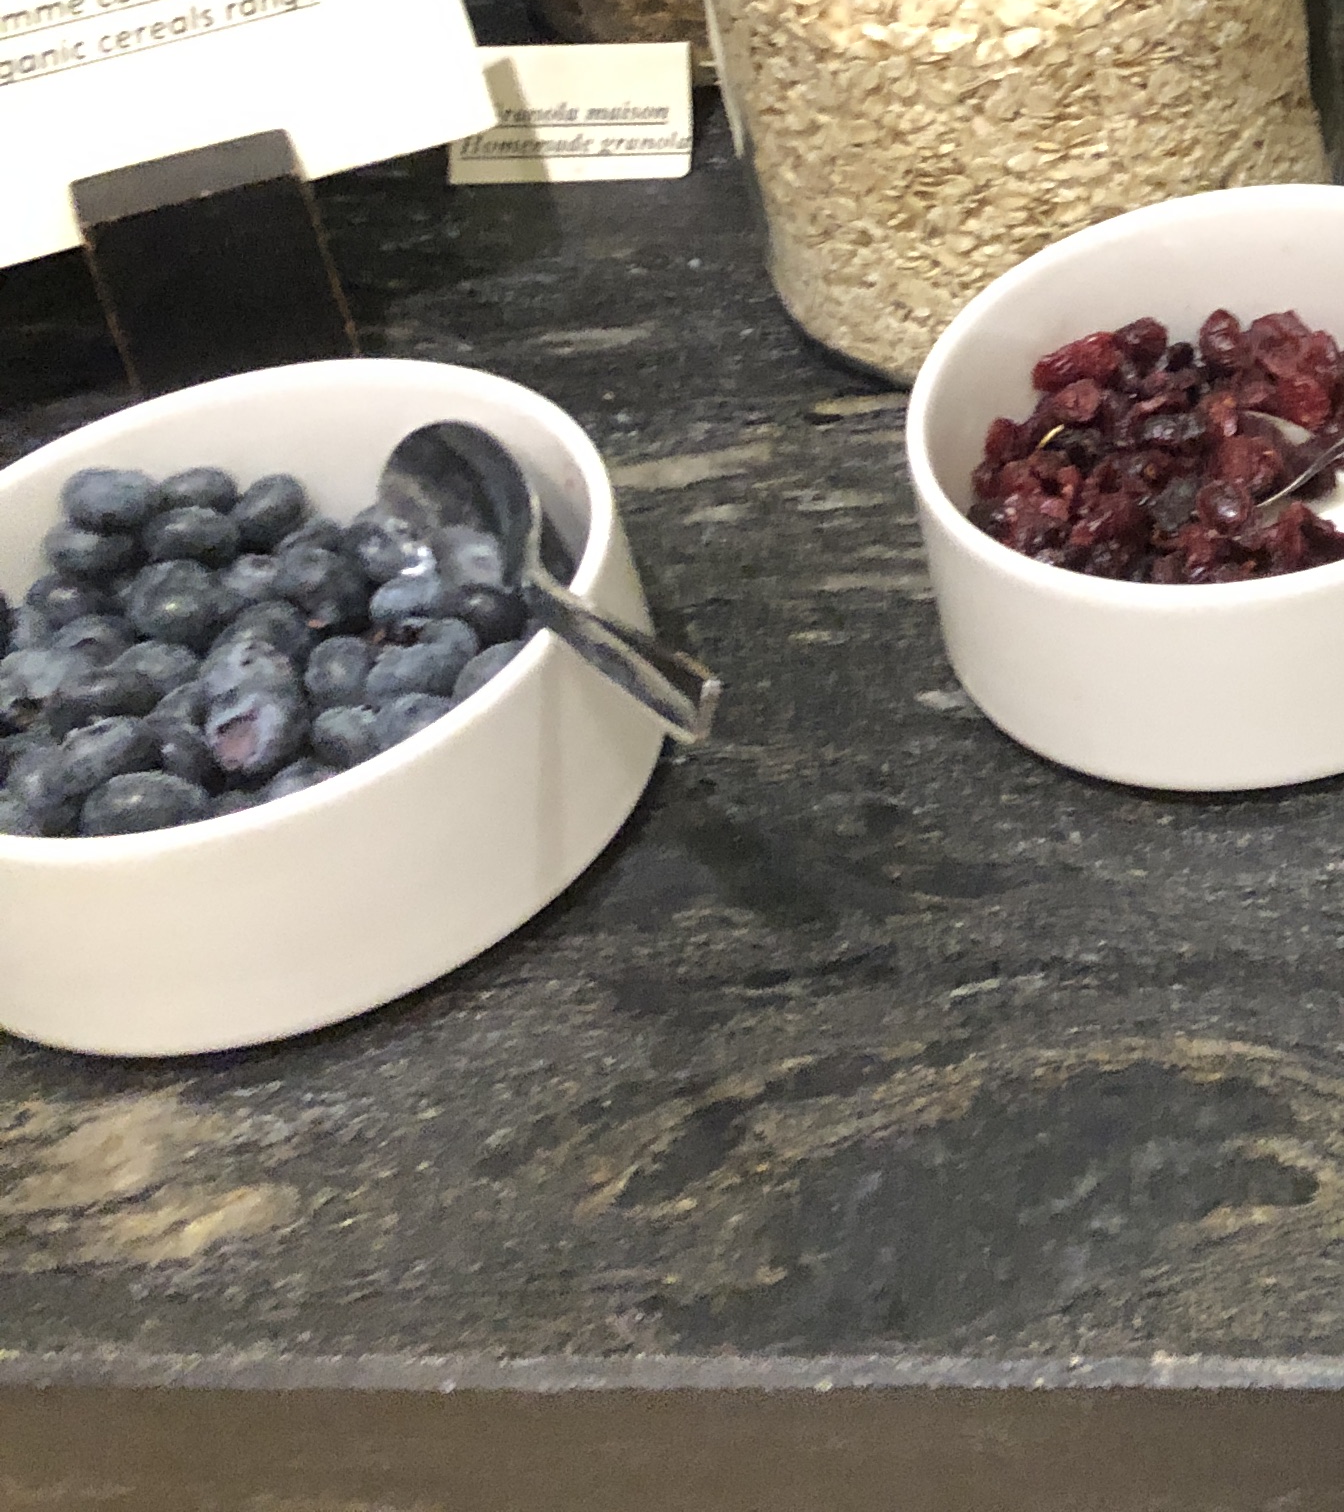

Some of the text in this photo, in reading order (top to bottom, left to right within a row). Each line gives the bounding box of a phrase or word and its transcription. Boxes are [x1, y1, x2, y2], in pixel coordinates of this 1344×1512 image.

[98, 6, 214, 52] cereals
[500, 100, 669, 121] ranola maison
[460, 133, 593, 155] Homemade
